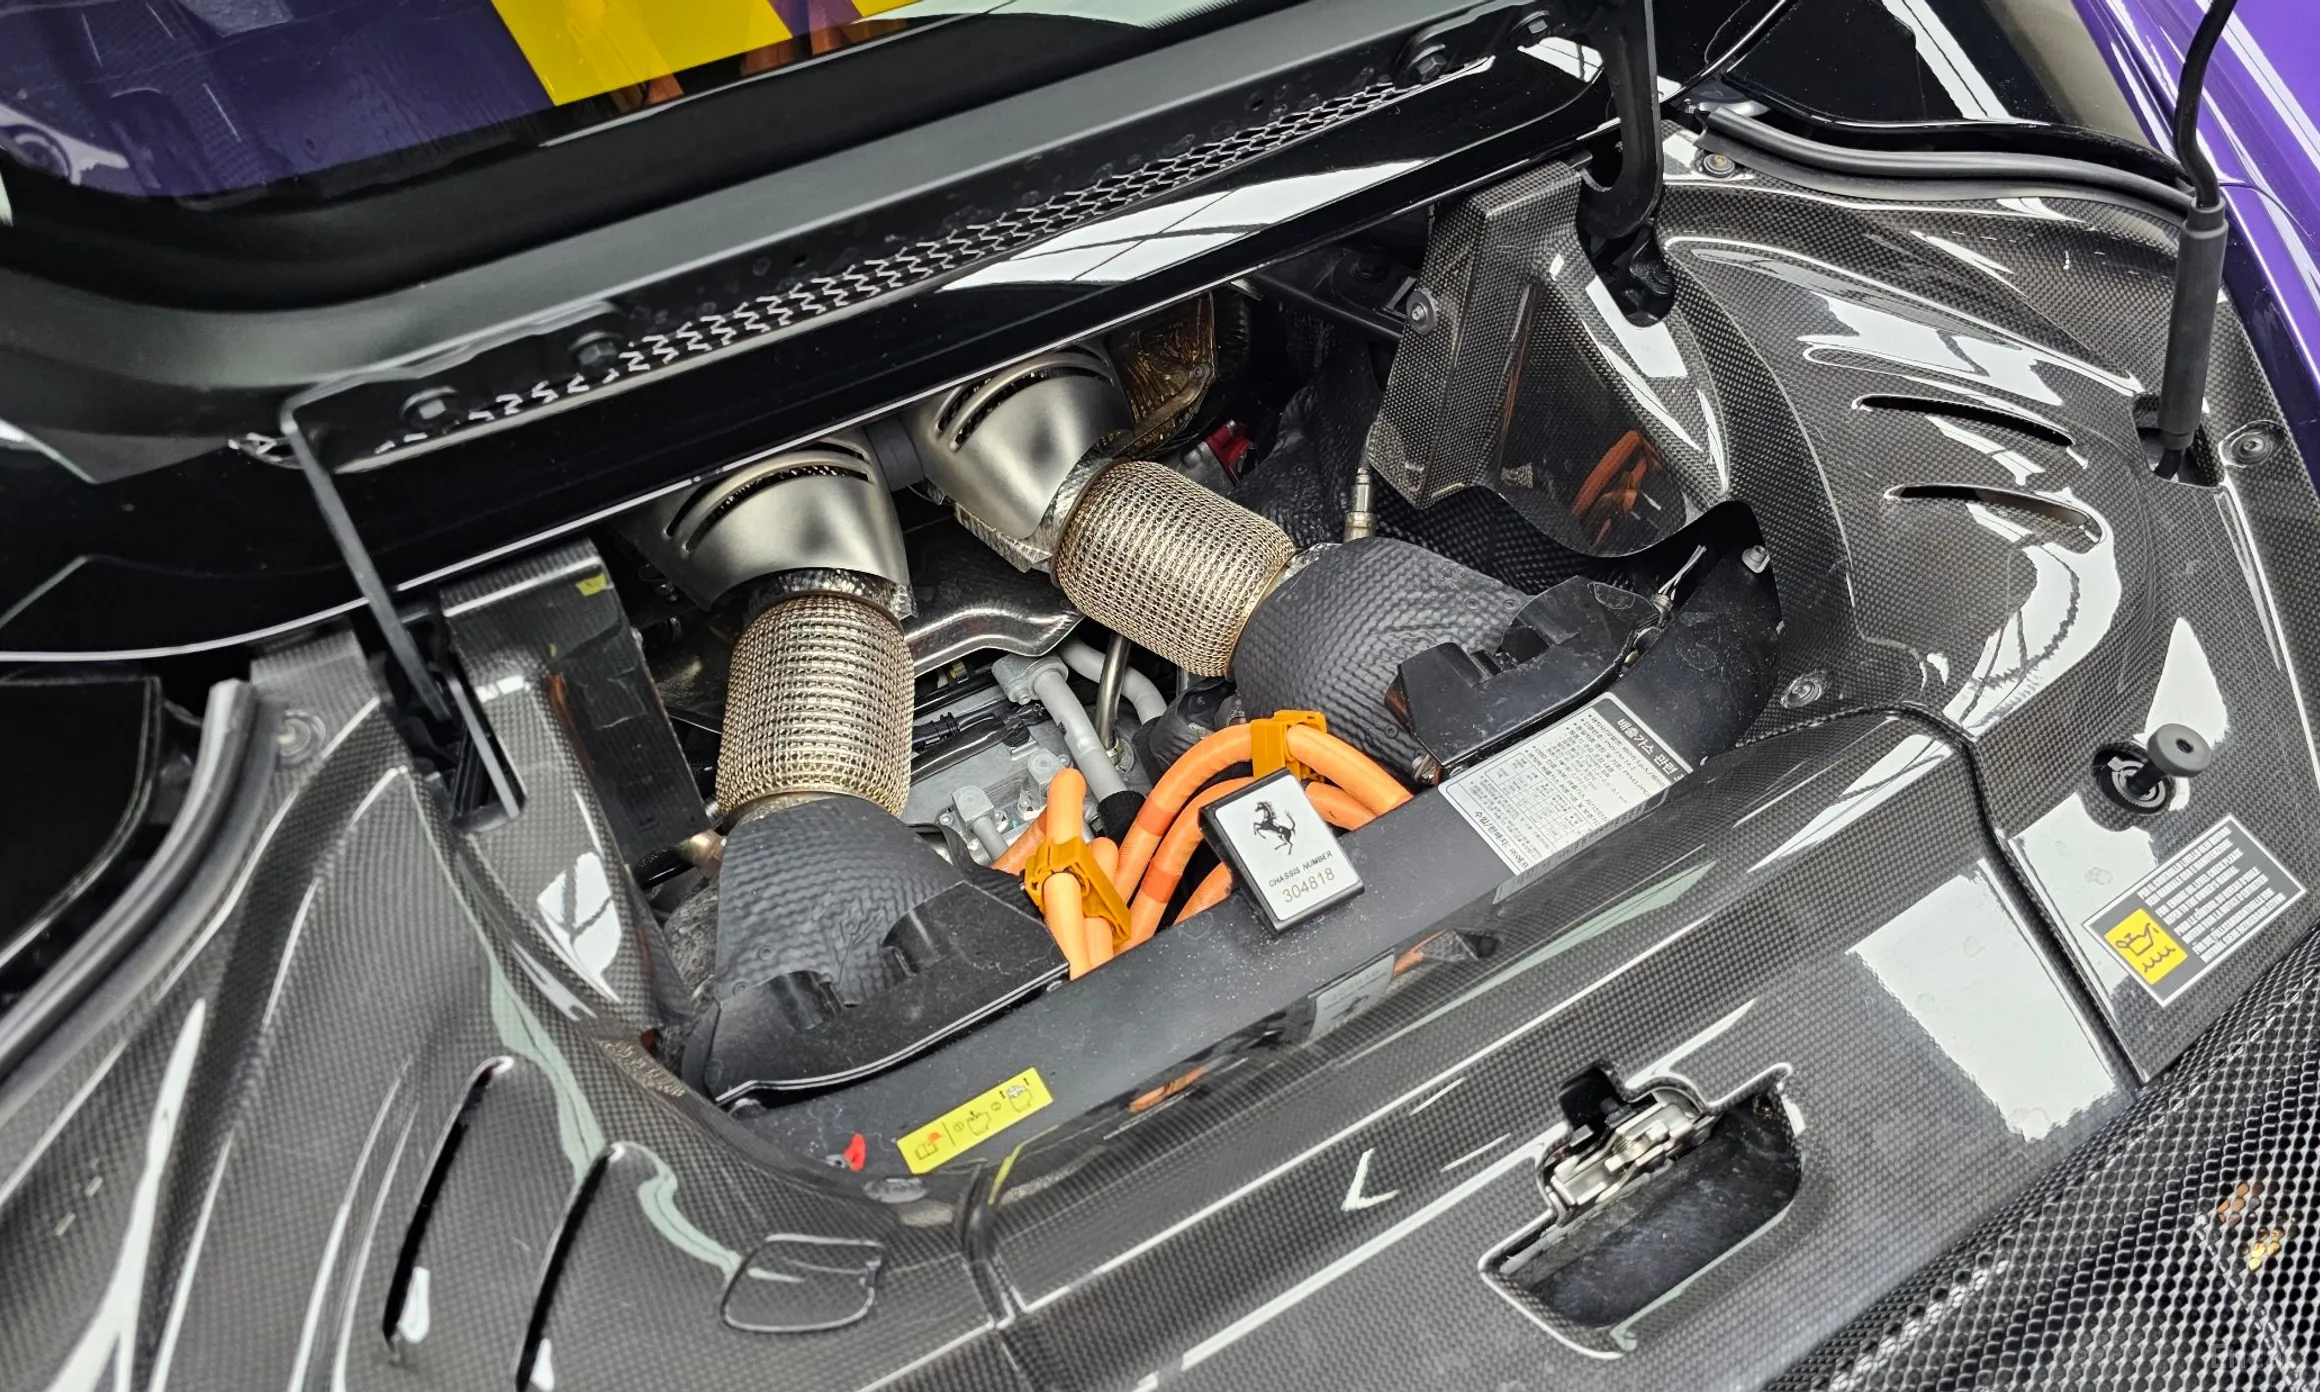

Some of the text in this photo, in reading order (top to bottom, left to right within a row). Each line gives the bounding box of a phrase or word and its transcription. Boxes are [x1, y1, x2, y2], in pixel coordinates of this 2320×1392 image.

[1614, 717, 1659, 755] 배출가스
[1651, 752, 1679, 775] 관련
[1268, 850, 1333, 888] CHASSIS NUMBER
[1282, 867, 1335, 903] 304818
